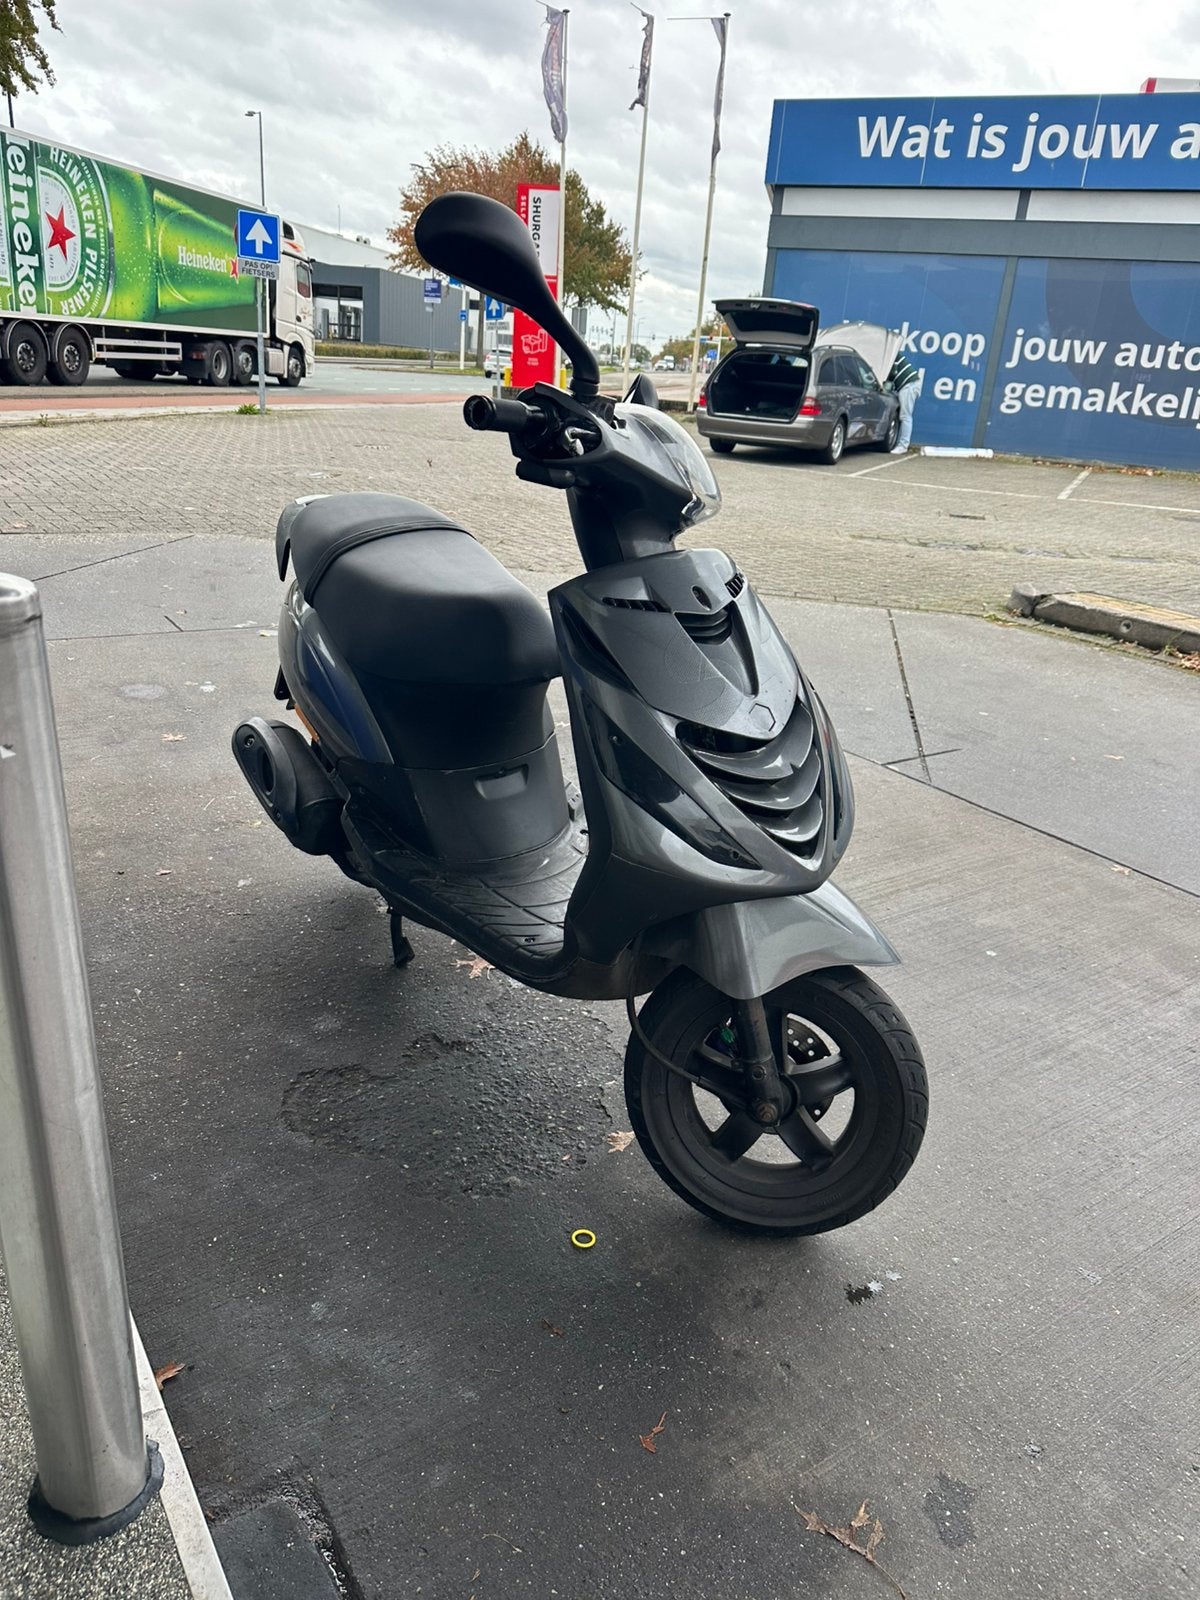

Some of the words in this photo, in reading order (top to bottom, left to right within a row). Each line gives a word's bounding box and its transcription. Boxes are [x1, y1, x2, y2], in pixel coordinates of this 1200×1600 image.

[857, 115, 954, 158] Wat
[966, 112, 1009, 158] is
[1011, 112, 1159, 172] jouw
[1170, 122, 1200, 159] a
[50, 147, 98, 239] HEINEKEN
[60, 249, 98, 316] PILSENER
[177, 245, 227, 273] Heineken
[241, 267, 276, 278] FIETSERS
[244, 260, 258, 269] PAS
[260, 262, 273, 271] OP!
[888, 321, 986, 366] koop
[1005, 328, 1107, 369] jouw
[1114, 340, 1200, 372] auto
[933, 376, 977, 402] en
[1000, 381, 1200, 430] gemakkeli
